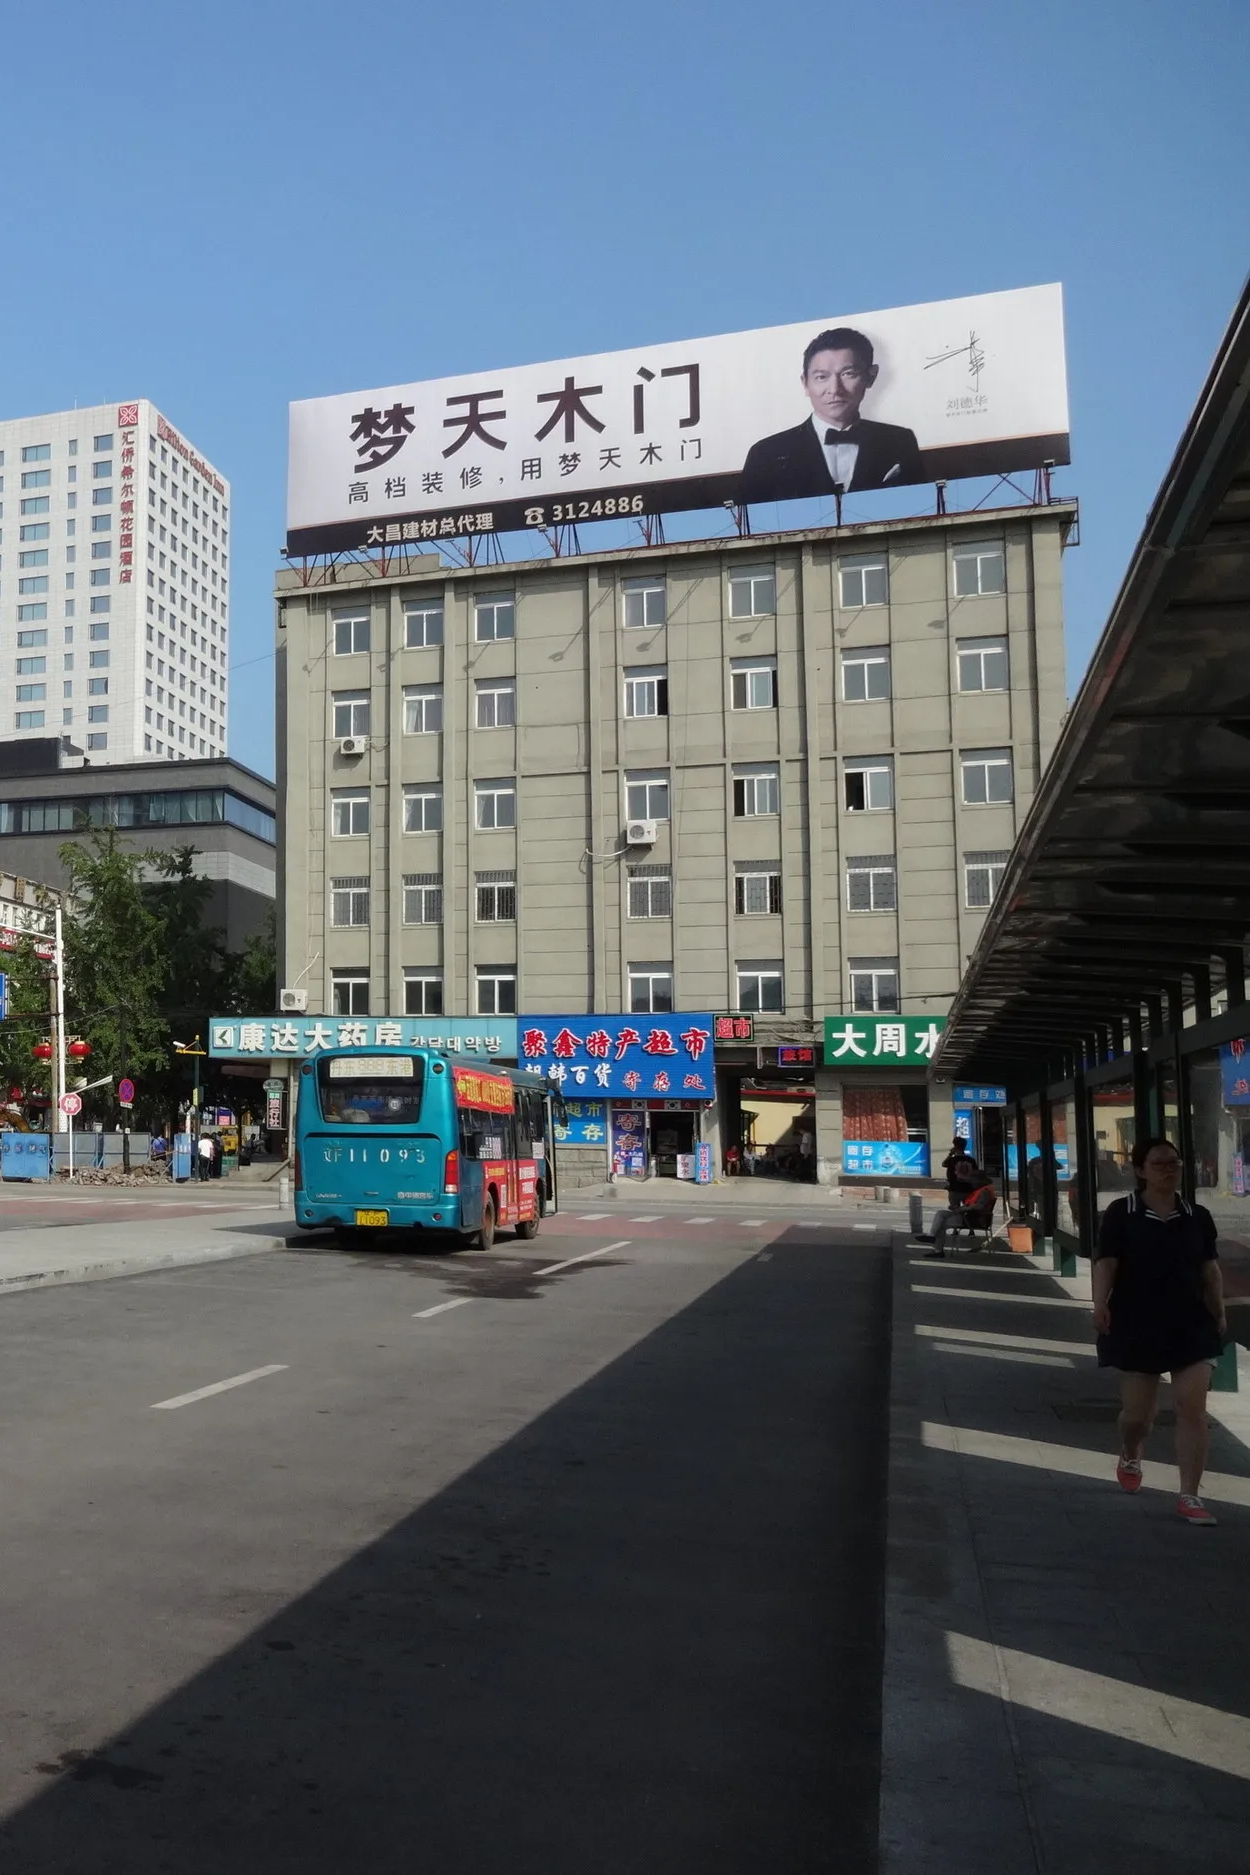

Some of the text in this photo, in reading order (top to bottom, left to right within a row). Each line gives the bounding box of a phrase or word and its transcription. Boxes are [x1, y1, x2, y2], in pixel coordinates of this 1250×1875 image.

[349, 363, 701, 474] 梦天木门
[948, 396, 987, 409] 刘德华
[190, 450, 213, 486] Garden
[213, 474, 225, 497] Inn
[119, 430, 135, 584] 汇侨希尔顿花园酒店
[366, 495, 644, 544] 大昌建材总代理 3124886
[239, 1022, 403, 1052] 康达大药房
[522, 1027, 711, 1061] 聚鑫特产超市
[716, 1018, 751, 1038] 超市
[622, 1071, 707, 1092] 寄存处
[554, 1124, 604, 1142] 寄存
[616, 1113, 643, 1151] 寄存
